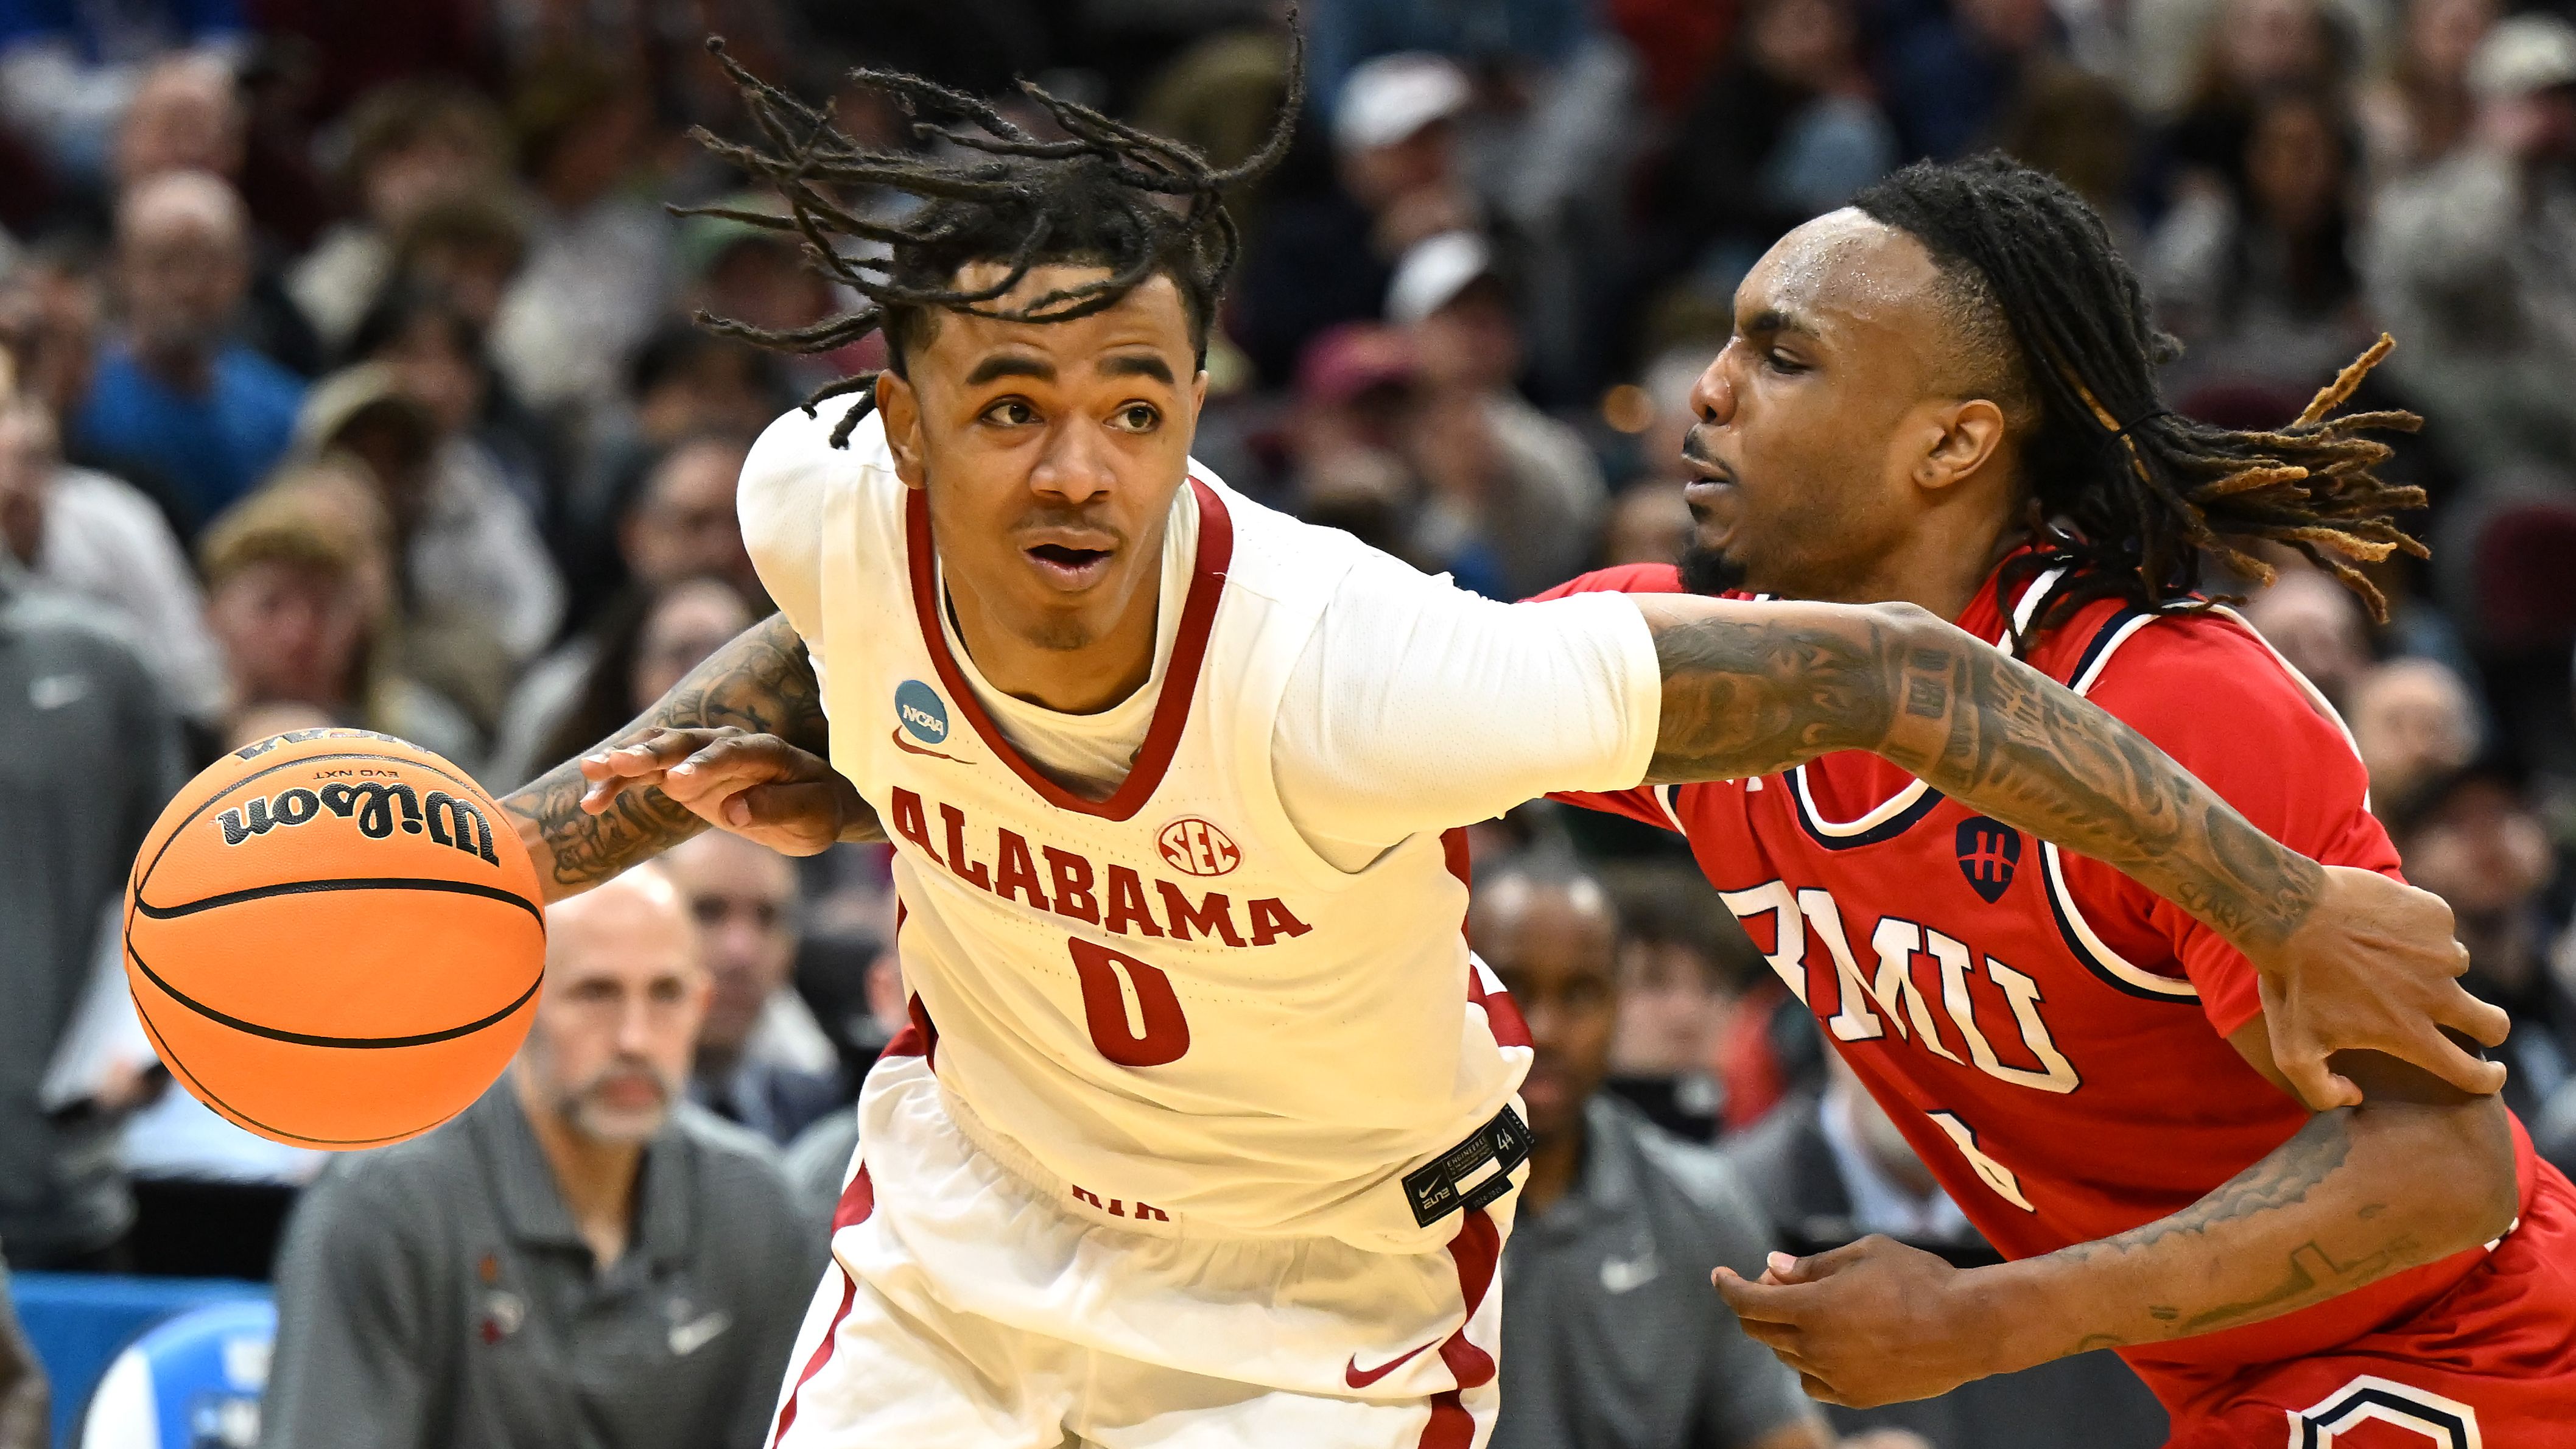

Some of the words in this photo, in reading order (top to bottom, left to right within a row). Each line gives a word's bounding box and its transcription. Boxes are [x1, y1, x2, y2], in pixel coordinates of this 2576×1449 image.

[903, 704, 944, 735] NCAA
[313, 770, 354, 780] NXT
[216, 781, 500, 868] Wilson
[1161, 821, 1237, 874] SEC
[891, 785, 1313, 948] ALABAMA
[1068, 936, 1190, 1067] 0
[1497, 1128, 1515, 1151] 44
